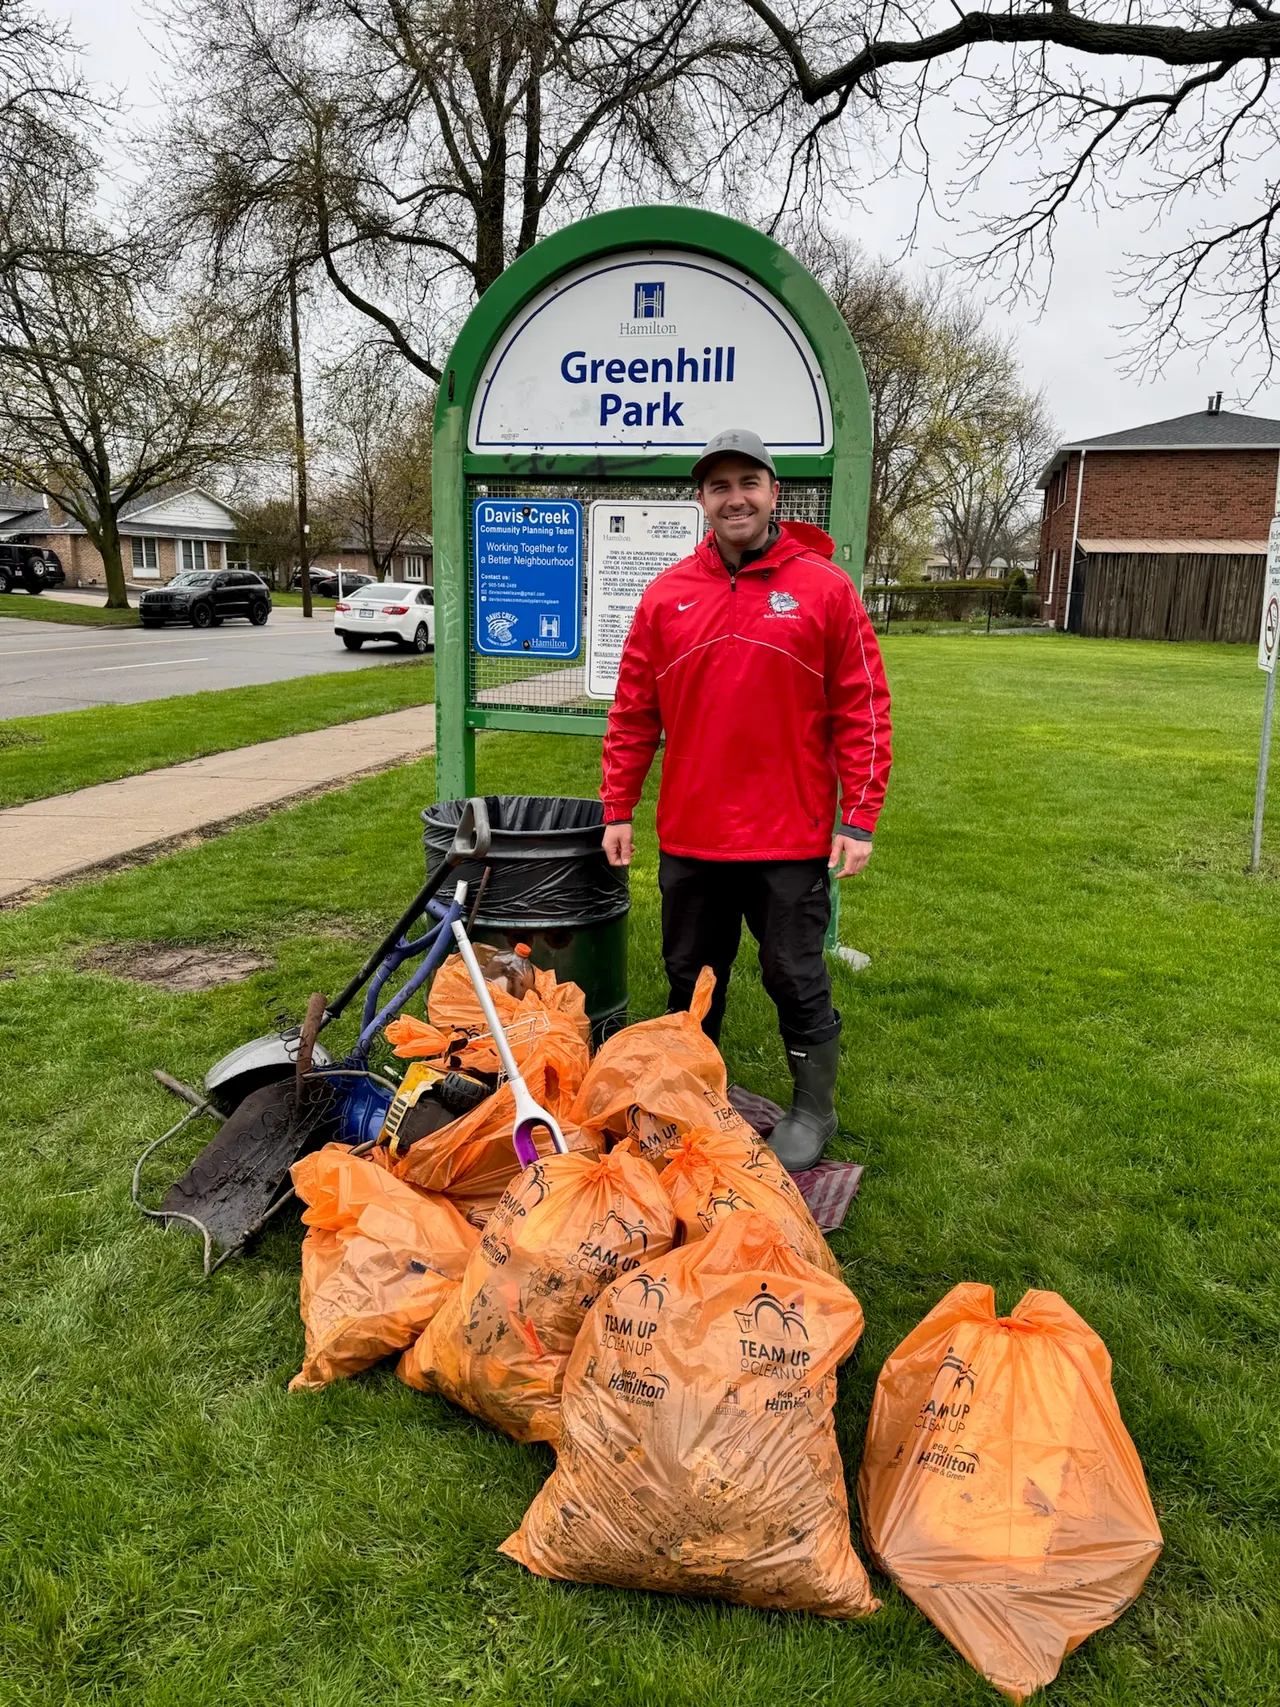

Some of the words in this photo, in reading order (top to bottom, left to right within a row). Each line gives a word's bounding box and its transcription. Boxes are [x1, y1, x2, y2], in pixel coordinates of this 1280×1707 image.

[620, 321, 677, 335] Hamilton
[561, 347, 735, 384] Greenhill
[600, 392, 684, 427] Park
[485, 508, 524, 523] Davis
[529, 508, 570, 524] Creek
[480, 525, 520, 535] Community
[522, 526, 554, 536] Planning
[555, 527, 575, 535] Team
[602, 534, 631, 542] Hamilton
[486, 542, 518, 554] Working
[520, 543, 555, 555] Together
[557, 544, 568, 553] for
[480, 556, 486, 564] a
[488, 555, 512, 564] Better
[514, 555, 574, 567] Neighbourhood
[485, 611, 501, 623] DAVIS
[531, 638, 567, 647] Hamilton
[639, 1133, 661, 1152] AM
[662, 1123, 677, 1139] UP
[577, 1242, 618, 1268] TEAM
[622, 1257, 640, 1272] UP
[605, 1314, 633, 1336] TEAM
[638, 1321, 657, 1339] UP
[607, 1335, 634, 1353] CLEAN
[636, 1341, 653, 1356] UP
[739, 1340, 785, 1364] TEAM
[791, 1349, 811, 1367] UP
[751, 1361, 790, 1380] CLEAN
[608, 1373, 665, 1400] Hamilton
[636, 1397, 655, 1407] Green
[951, 1403, 970, 1419] UP
[949, 1420, 965, 1434] UP
[932, 1442, 948, 1454] eep
[946, 1471, 966, 1481] Green
